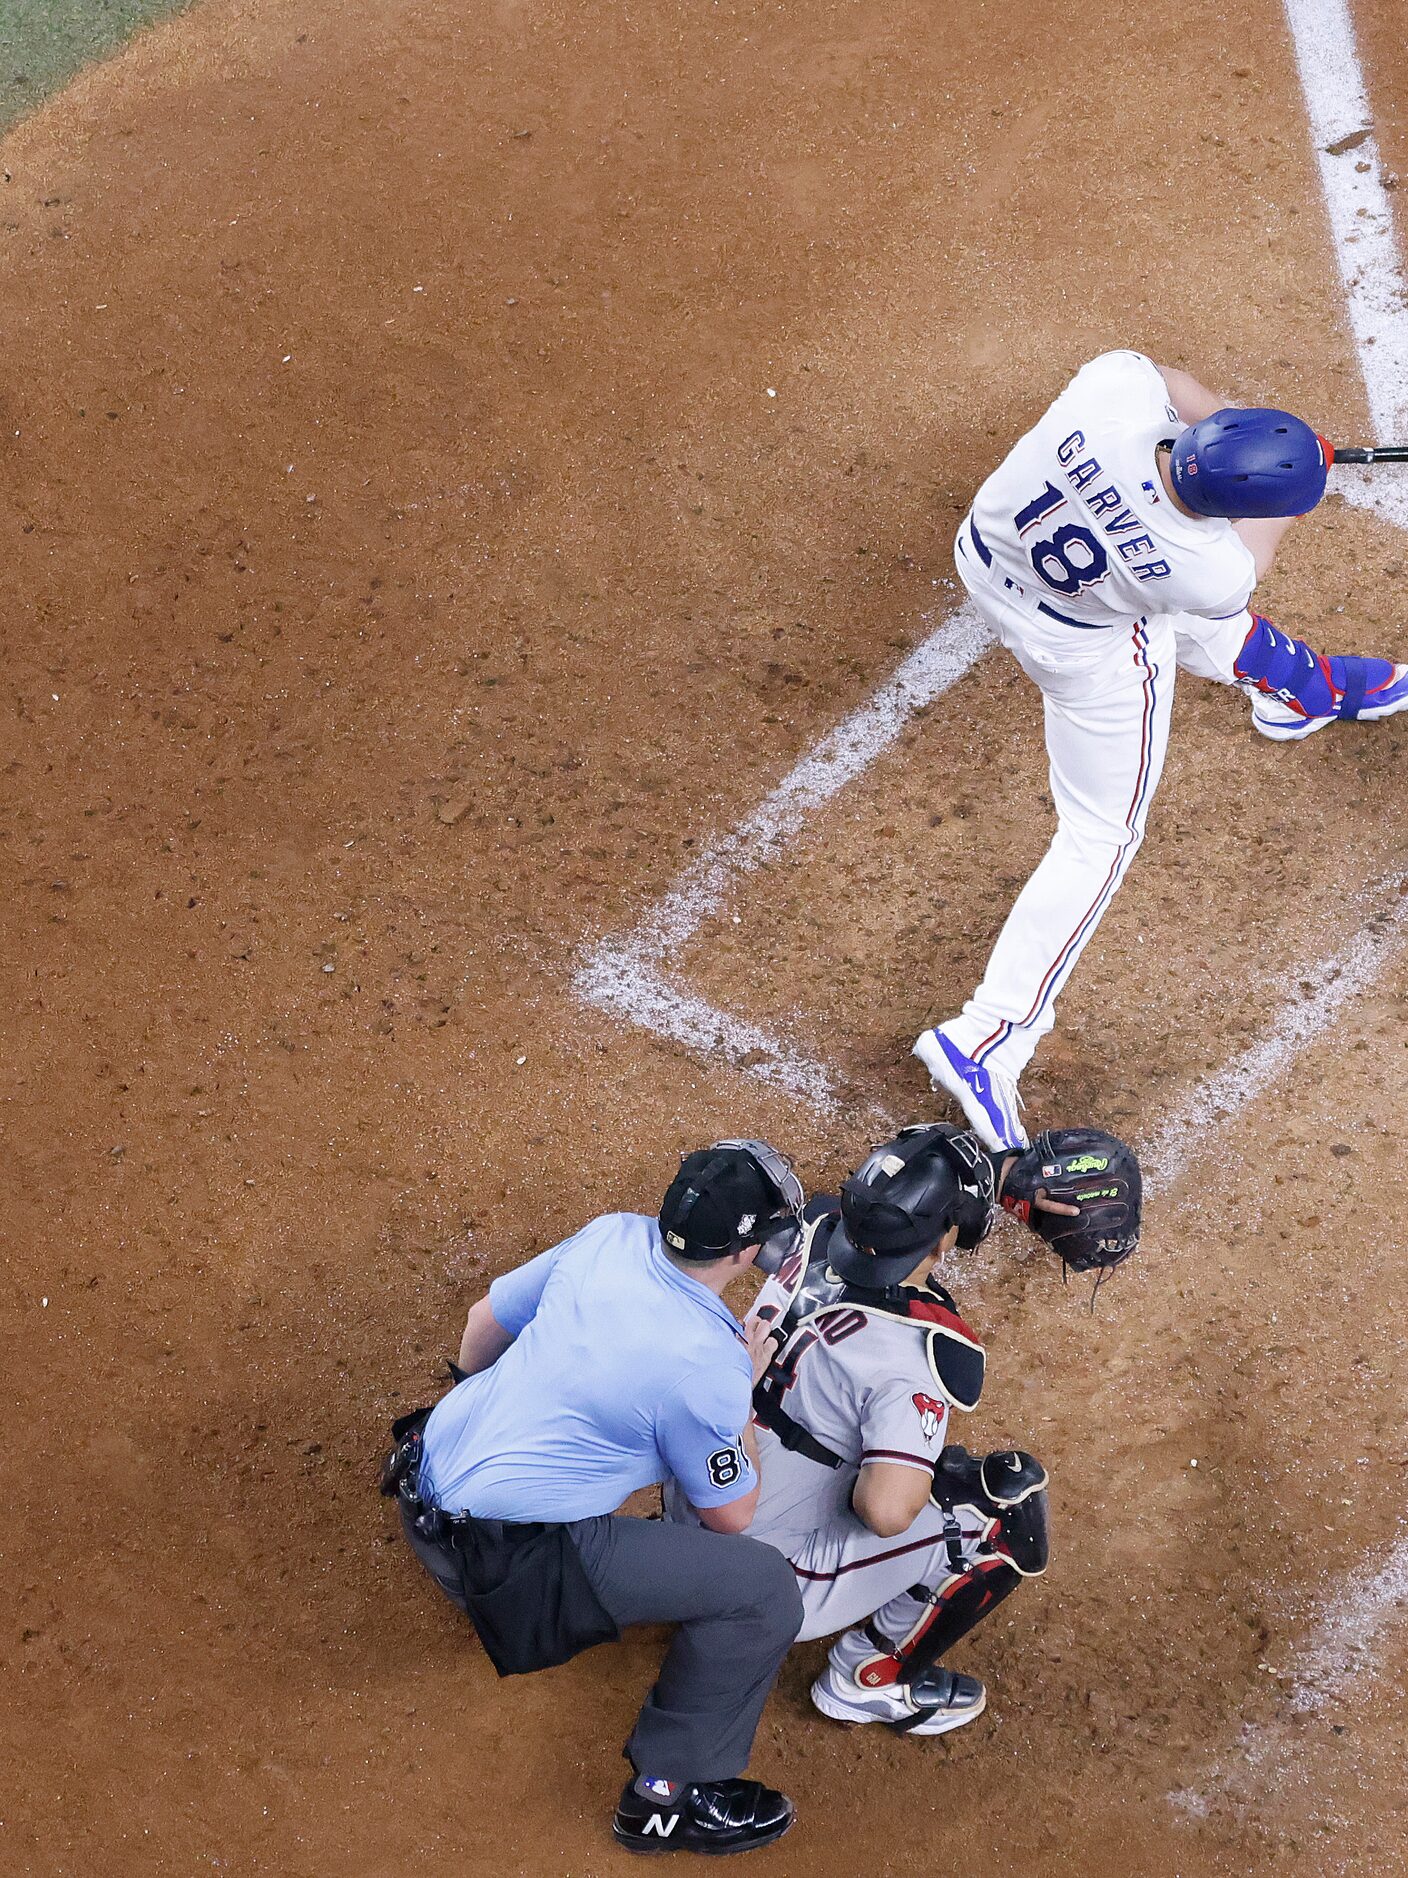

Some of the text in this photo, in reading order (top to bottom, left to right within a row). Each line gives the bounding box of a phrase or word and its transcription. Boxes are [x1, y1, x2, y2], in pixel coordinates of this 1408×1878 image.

[1186, 454, 1198, 475] 18
[1013, 479, 1111, 597] 18
[1056, 429, 1172, 582] GARVER
[641, 1813, 680, 1838] N
